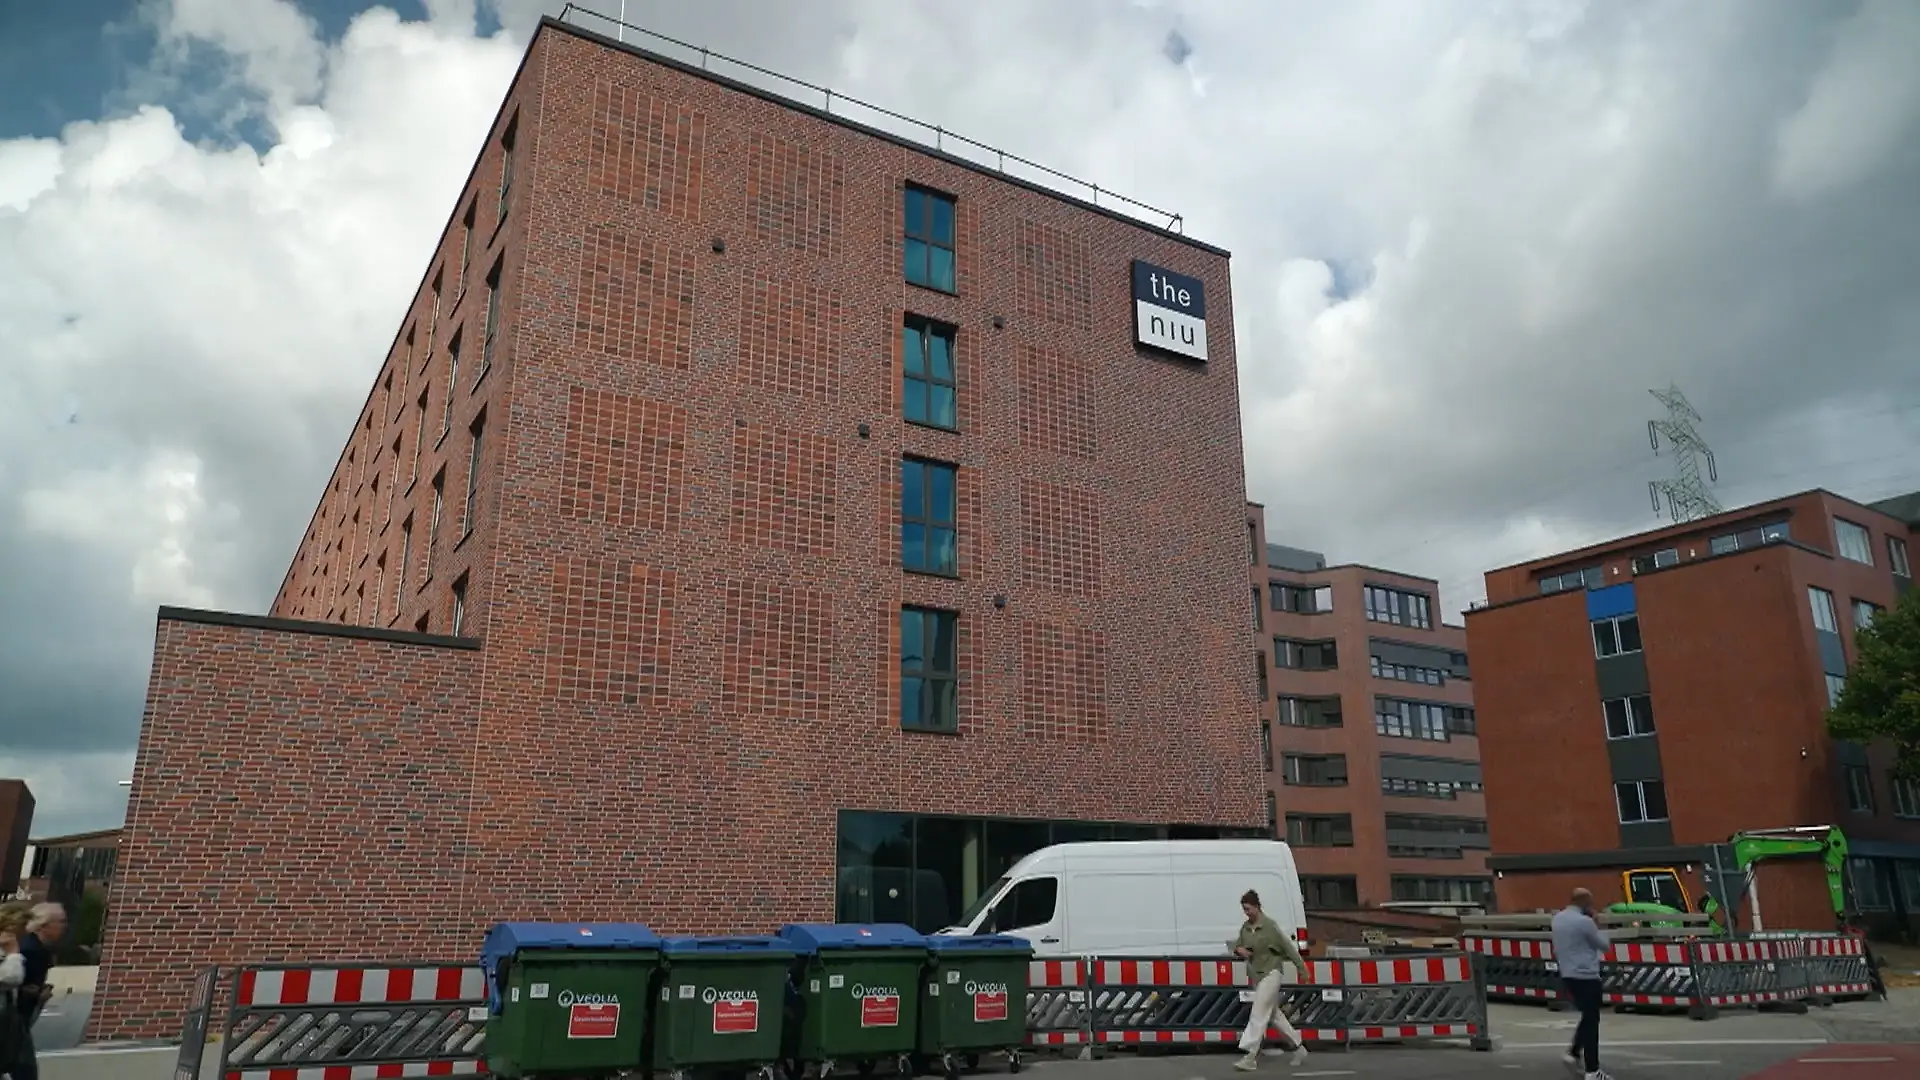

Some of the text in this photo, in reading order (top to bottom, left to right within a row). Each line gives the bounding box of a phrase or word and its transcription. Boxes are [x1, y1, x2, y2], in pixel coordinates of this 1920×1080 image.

[1150, 273, 1191, 307] the
[1151, 315, 1195, 346] niu
[576, 992, 619, 1004] VEOLIA
[718, 990, 758, 1000] VEOLIA
